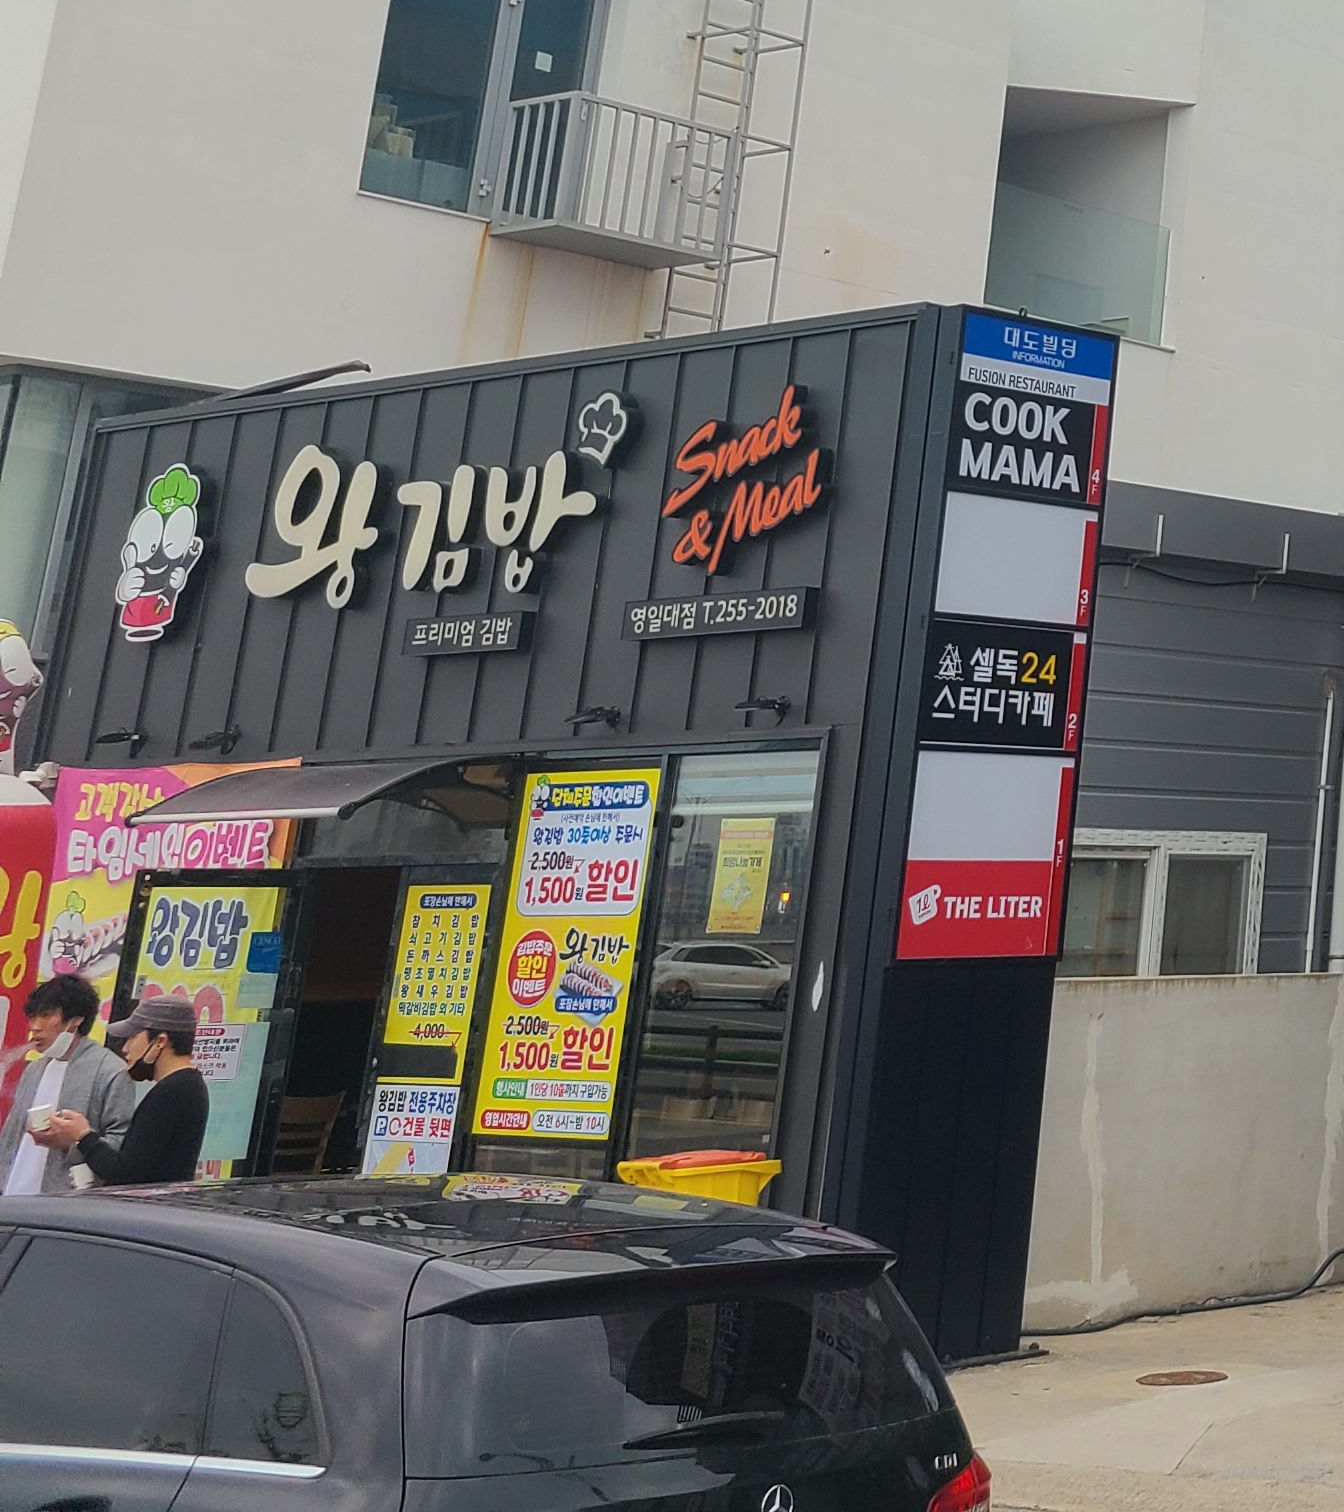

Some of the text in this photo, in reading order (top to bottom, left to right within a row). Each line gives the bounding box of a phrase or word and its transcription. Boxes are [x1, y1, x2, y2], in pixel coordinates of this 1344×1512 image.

[1004, 326, 1077, 358] 대도빌딩
[1012, 351, 1065, 368] INFORMATION
[968, 367, 1076, 398] FUSION RESTAURANT
[964, 392, 1071, 445] COOK
[664, 386, 802, 517] Snack
[959, 438, 1080, 493] MAMA
[672, 466, 821, 575] & Meal
[630, 594, 798, 633] 영일대점 T.255-2018
[412, 618, 512, 647] 프리미엄 김밥
[969, 646, 1056, 685] 셀독24
[932, 685, 1055, 727] 스터디카페
[533, 827, 564, 845] 왕김밥
[615, 824, 643, 844] 주문시
[586, 859, 639, 902] 할인
[944, 896, 1042, 919] THE LITER
[147, 897, 248, 968] 왕김밥
[517, 940, 553, 956] 김밥주문
[517, 957, 548, 979] 할인
[512, 979, 546, 998] 이벤트
[449, 1003, 465, 1017] 기타
[561, 1026, 614, 1071] 할인
[378, 1090, 456, 1115] 왕김밥 전용주차장
[580, 1083, 608, 1099] 구입가능
[403, 1116, 451, 1138] 건물 뒷면
[484, 1112, 527, 1128] 영업시간안내
[537, 1114, 553, 1128] 오전
[586, 1115, 605, 1130] 10시
[935, 1452, 958, 1470] CDI
